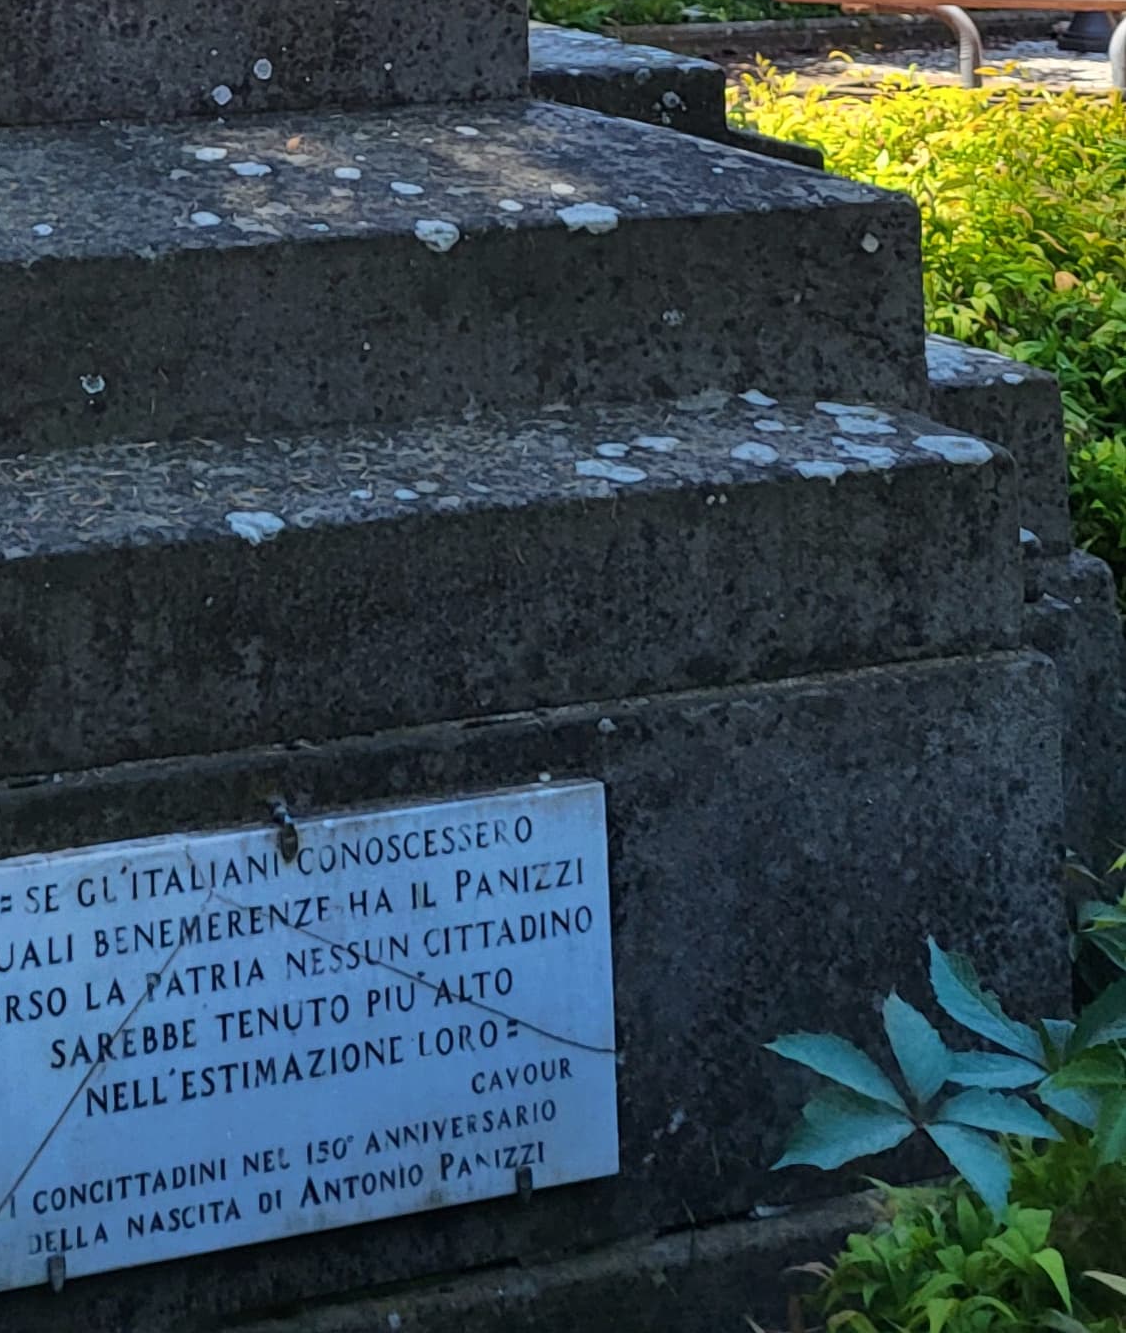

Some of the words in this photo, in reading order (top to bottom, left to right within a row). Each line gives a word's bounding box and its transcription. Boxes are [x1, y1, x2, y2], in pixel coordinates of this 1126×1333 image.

[297, 815, 533, 875] CONOSCESSERO
[85, 977, 126, 1012] LA
[145, 957, 265, 1003] PATRIA
[286, 933, 410, 981] NESSUN
[424, 905, 593, 959] CITTADINO
[94, 896, 330, 959] BENEMERENZE
[349, 886, 393, 917] HA
[410, 881, 437, 911] IL
[455, 857, 585, 903] PANIZZI
[50, 1019, 197, 1070] SAREBBE
[214, 993, 349, 1044] TENUTO
[433, 967, 514, 1008] ALTO
[85, 1035, 404, 1118] NELL'ESTIMAZIONE
[471, 1056, 573, 1095] CAVOUR
[9, 1195, 16, 1219] I
[32, 1157, 227, 1216] CONCITTADINI
[242, 1147, 291, 1177] NEL
[365, 1099, 557, 1156] ANNIVERSARIO
[27, 1222, 109, 1256] DELLA
[127, 1197, 242, 1238] NASCITA
[258, 1188, 282, 1215] DI
[300, 1162, 423, 1209] ANTONIO
[440, 1141, 545, 1182] PANIZZI
